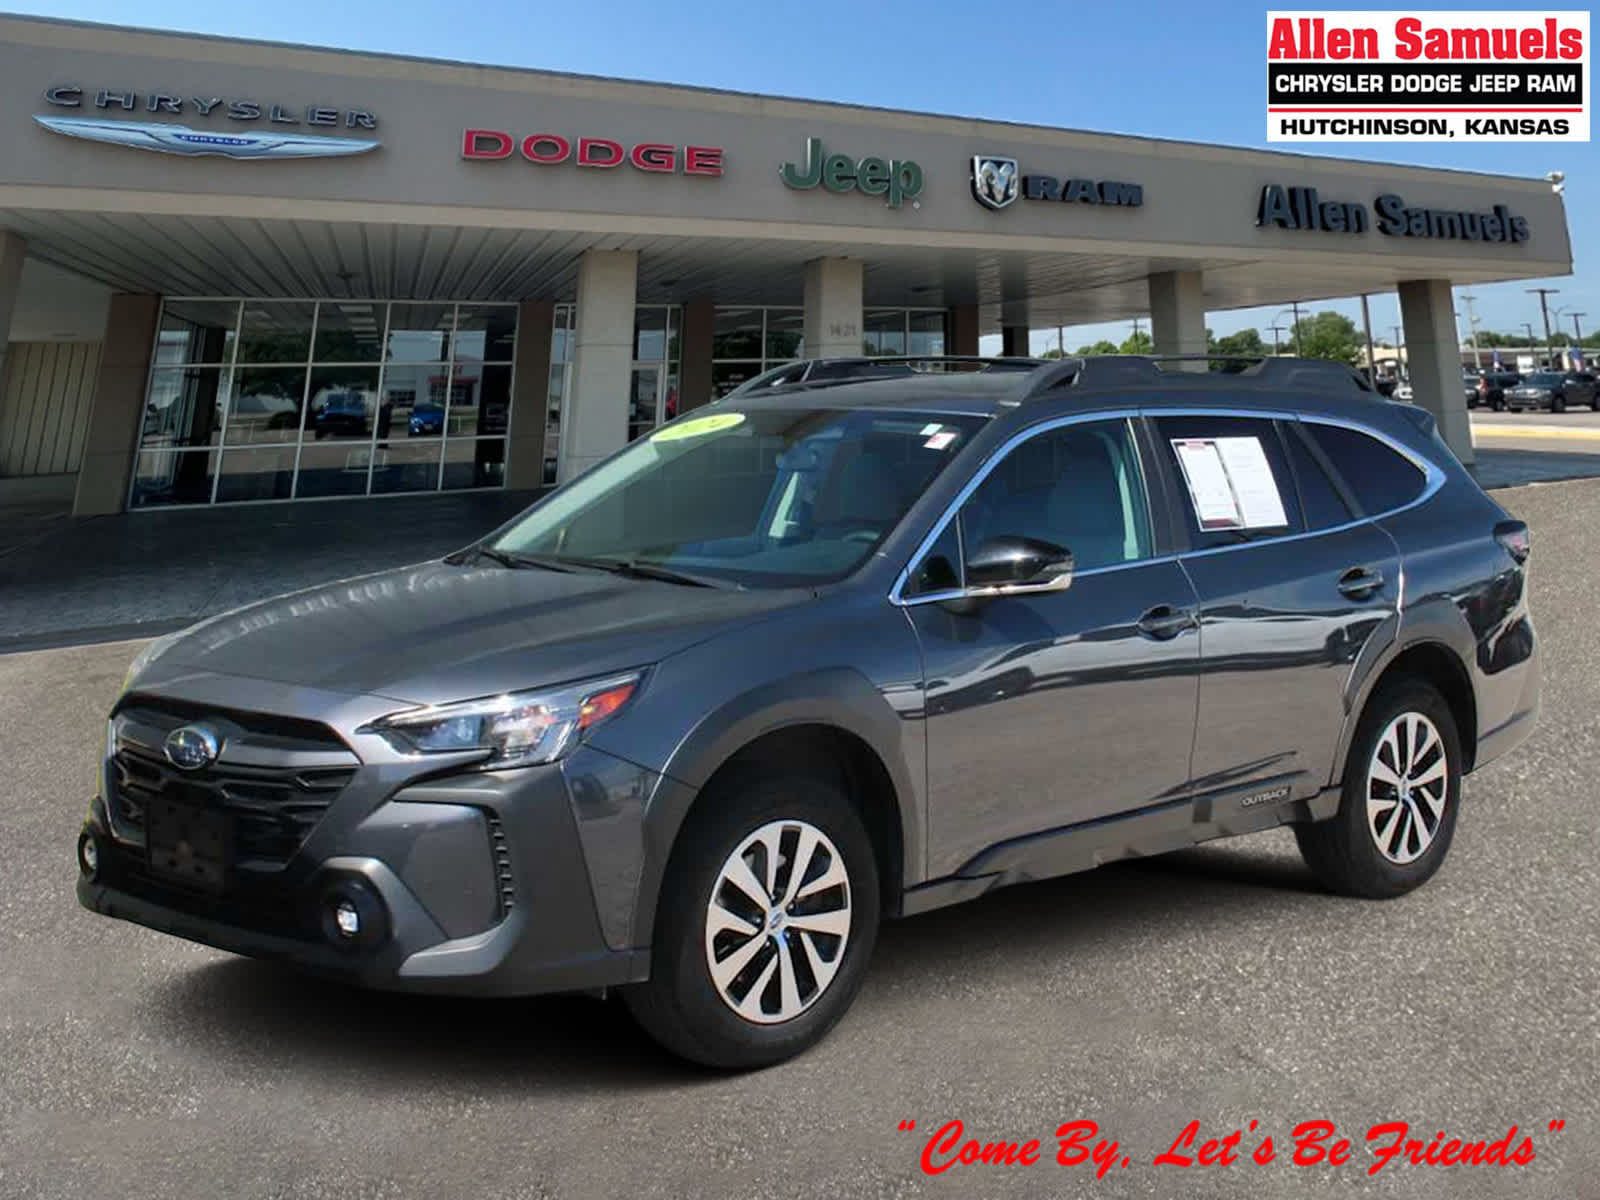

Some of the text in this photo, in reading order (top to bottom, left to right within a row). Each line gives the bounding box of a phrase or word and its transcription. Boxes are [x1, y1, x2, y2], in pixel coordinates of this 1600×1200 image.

[43, 86, 378, 129] CHRYSLER
[461, 128, 724, 176] DODGE
[778, 136, 924, 209] Jeep
[1022, 175, 1144, 207] RAM
[1257, 184, 1530, 243] Allen Samuels
